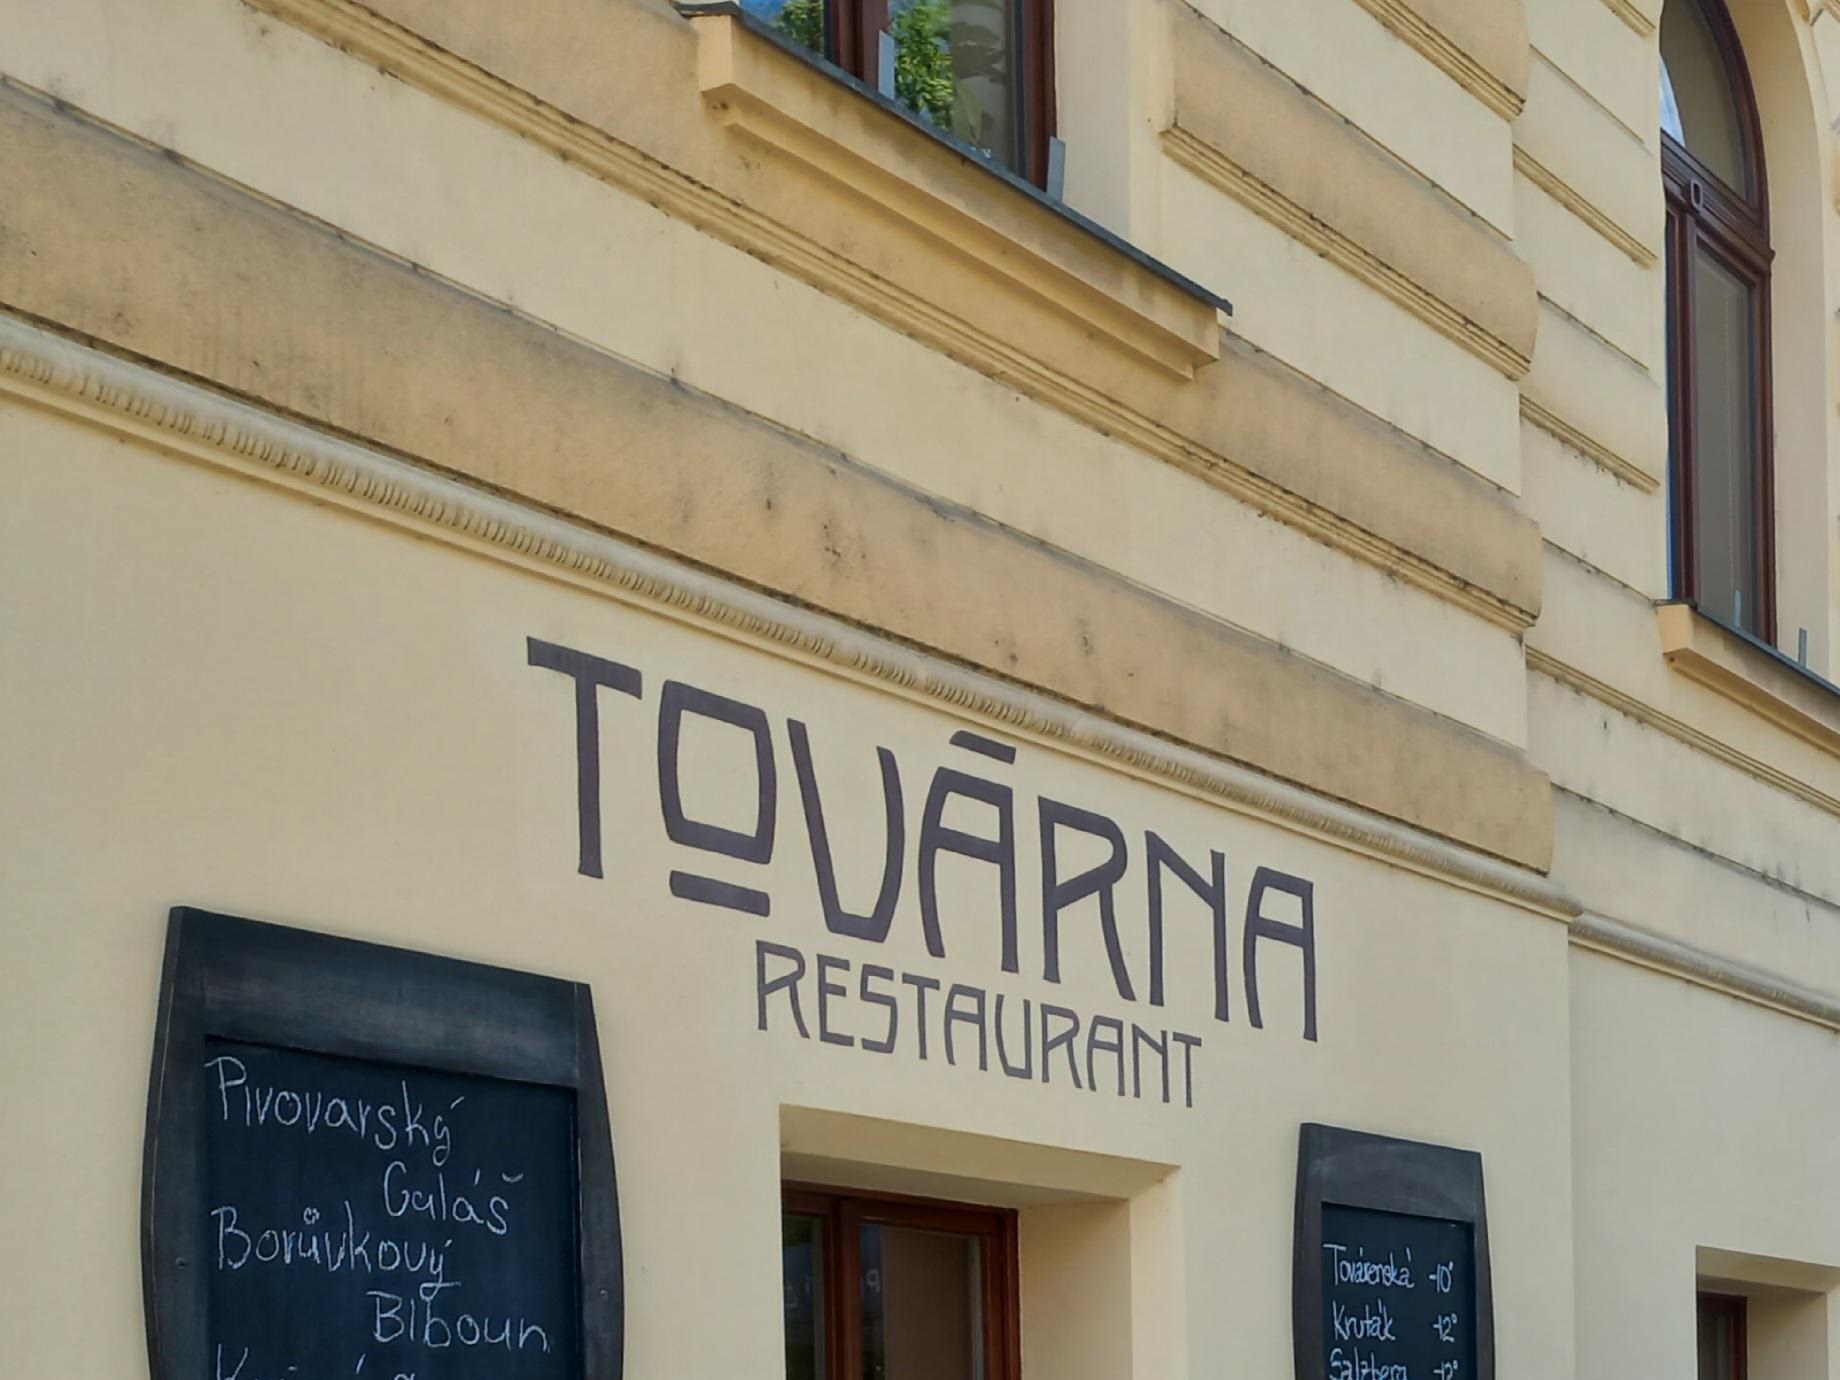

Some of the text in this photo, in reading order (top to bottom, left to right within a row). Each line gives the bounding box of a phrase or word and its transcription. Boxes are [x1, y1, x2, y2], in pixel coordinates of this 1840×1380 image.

[756, 940, 1202, 1106] RESTAURANT
[204, 1056, 464, 1166] Pivovarský
[211, 1201, 461, 1300] Borůvkový
[367, 1291, 550, 1353] Blboun
[1333, 1299, 1396, 1341] Kruták
